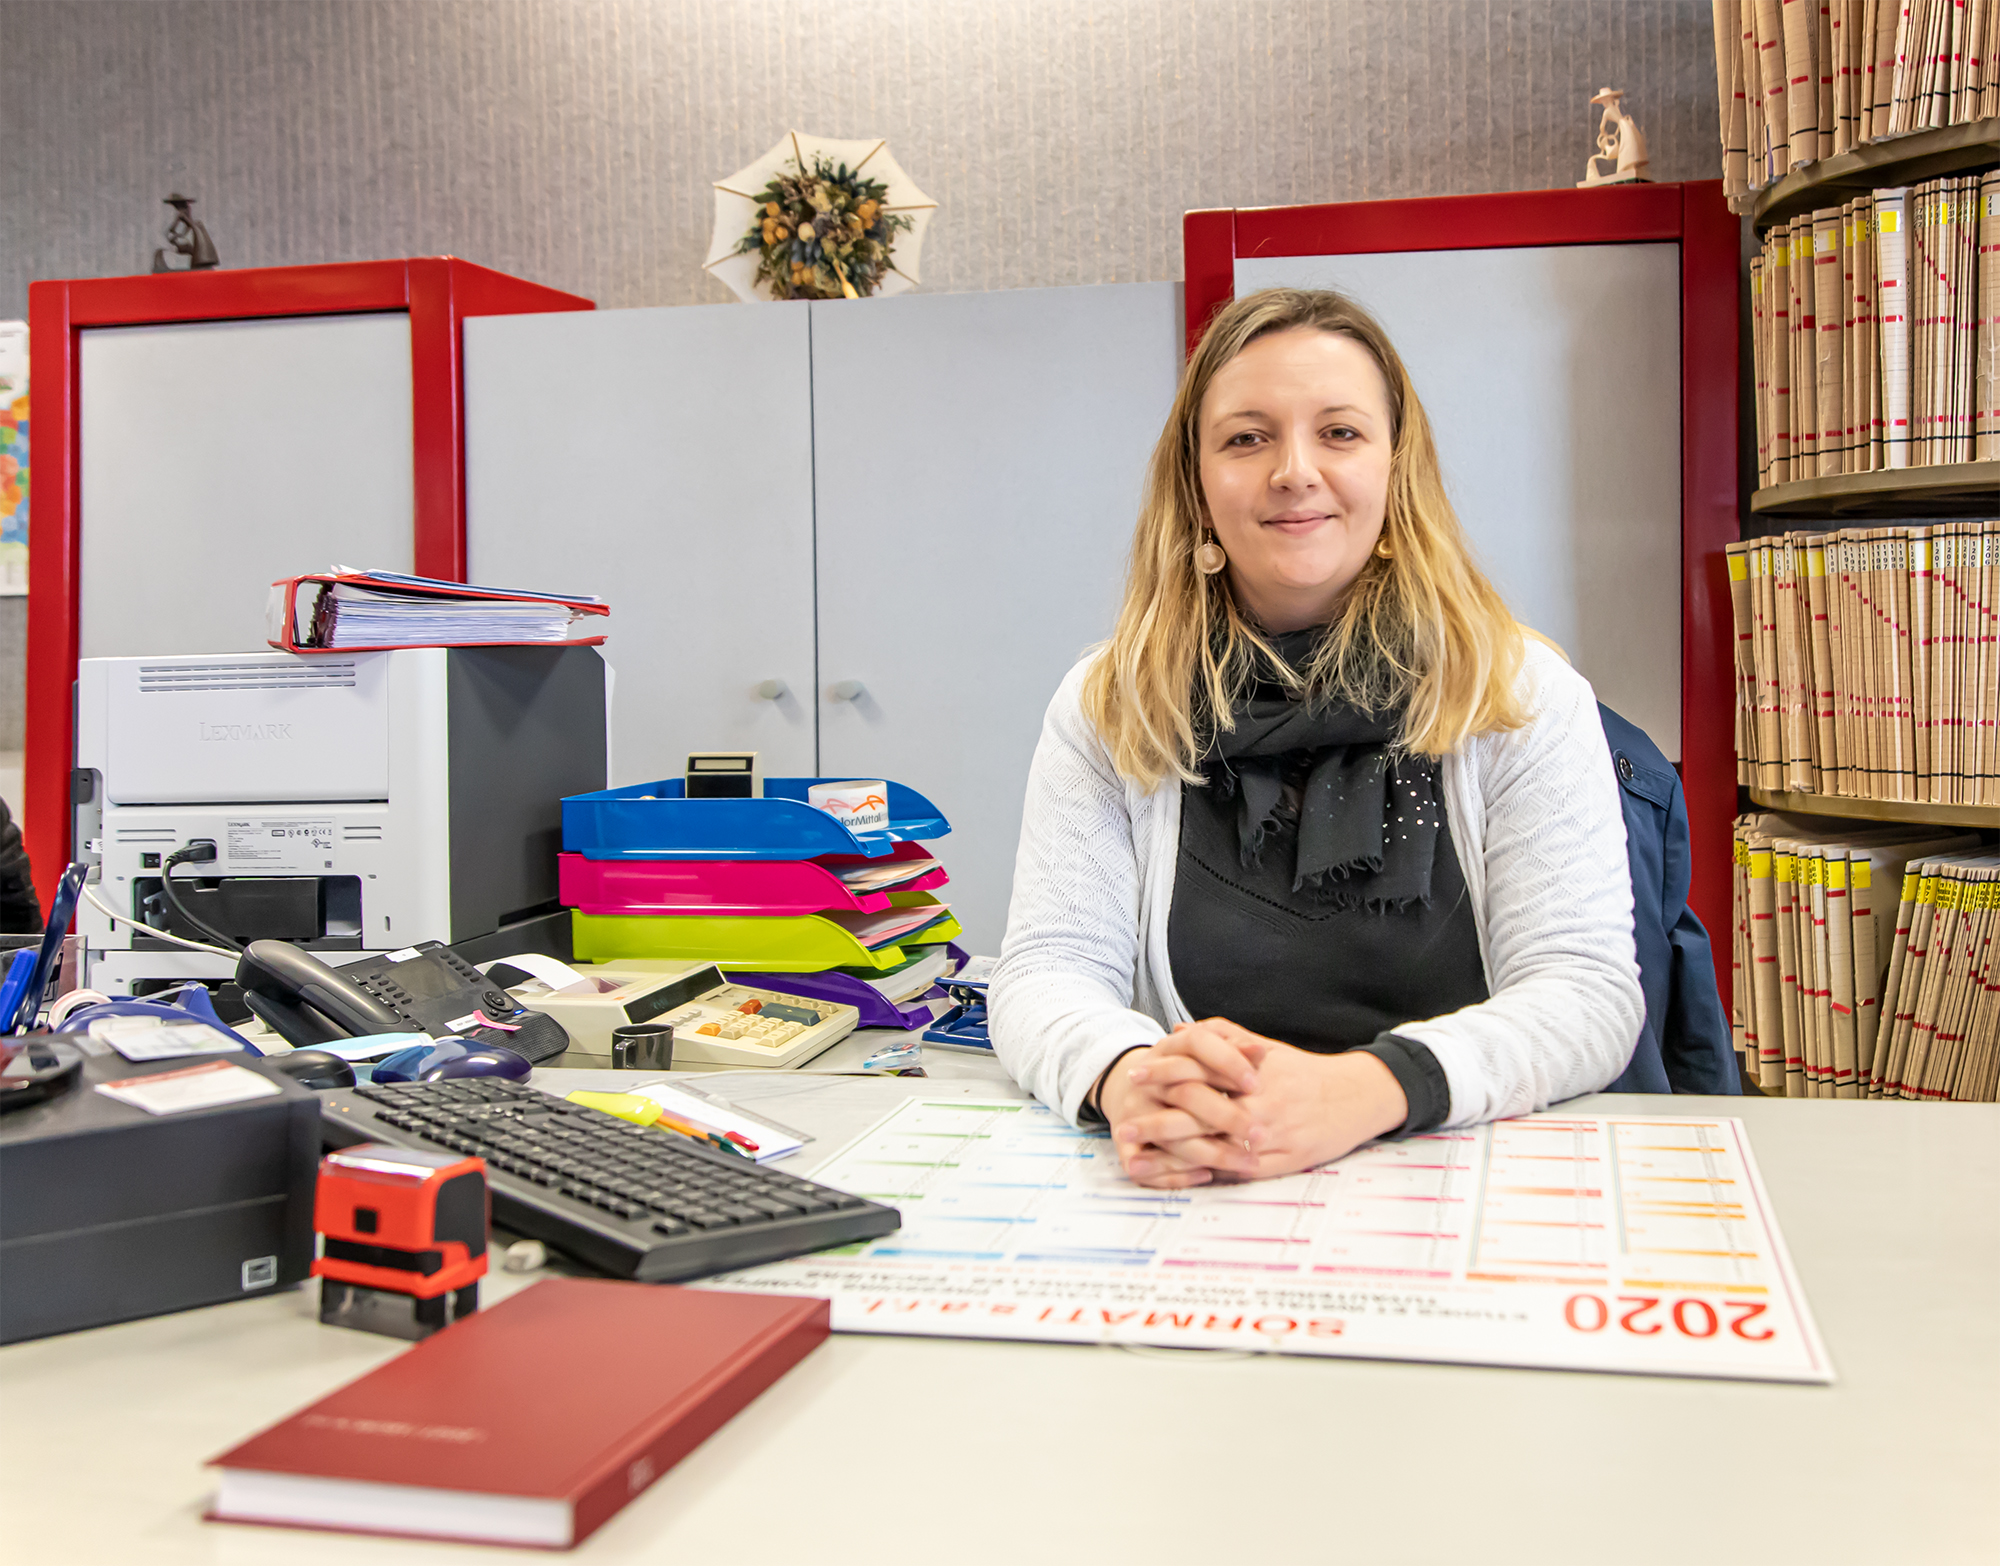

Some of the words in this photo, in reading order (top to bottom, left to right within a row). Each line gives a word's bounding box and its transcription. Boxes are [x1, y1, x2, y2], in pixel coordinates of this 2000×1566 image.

[199, 721, 293, 741] LEXMARK
[840, 812, 882, 827] lorMittal
[1037, 1304, 1345, 1338] SORMATI
[1564, 1293, 1776, 1341] 2020
